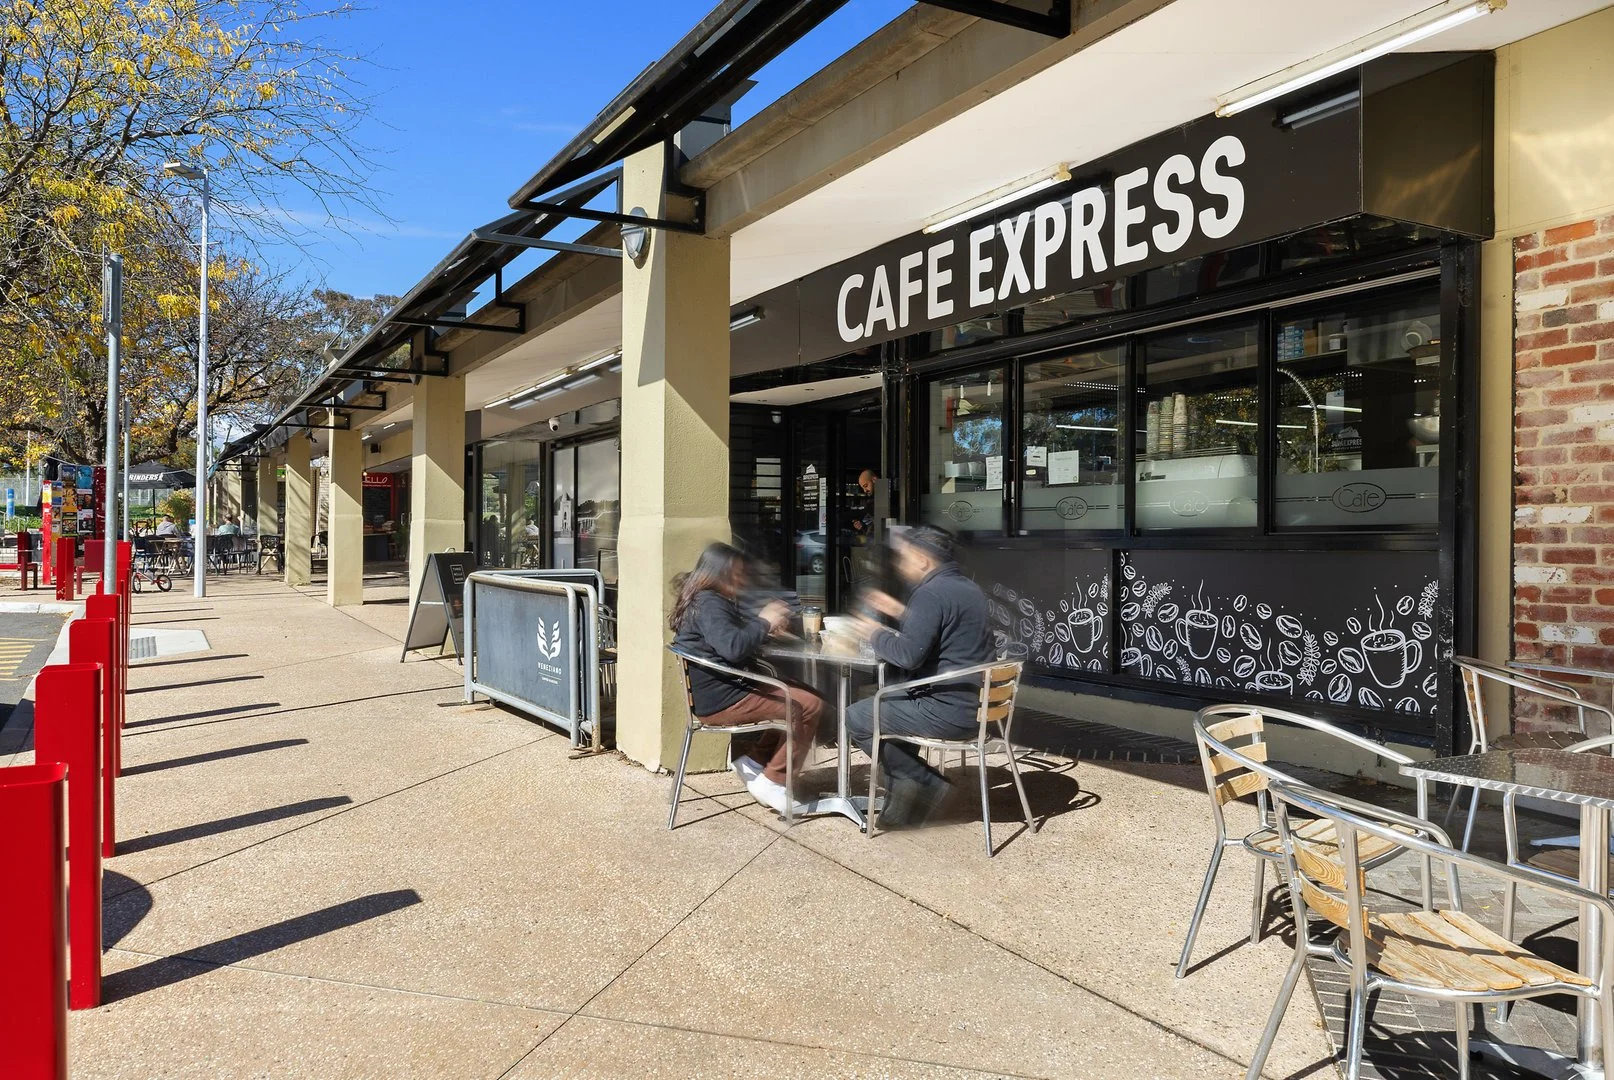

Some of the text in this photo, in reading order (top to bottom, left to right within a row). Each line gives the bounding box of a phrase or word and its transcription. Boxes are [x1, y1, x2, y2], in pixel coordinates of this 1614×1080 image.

[837, 136, 1246, 342] CAFE EXPRESS
[363, 475, 388, 483] ELLO
[1338, 488, 1379, 507] Cafe
[1061, 501, 1084, 516] Cafe
[538, 661, 562, 675] VENEZIANO
